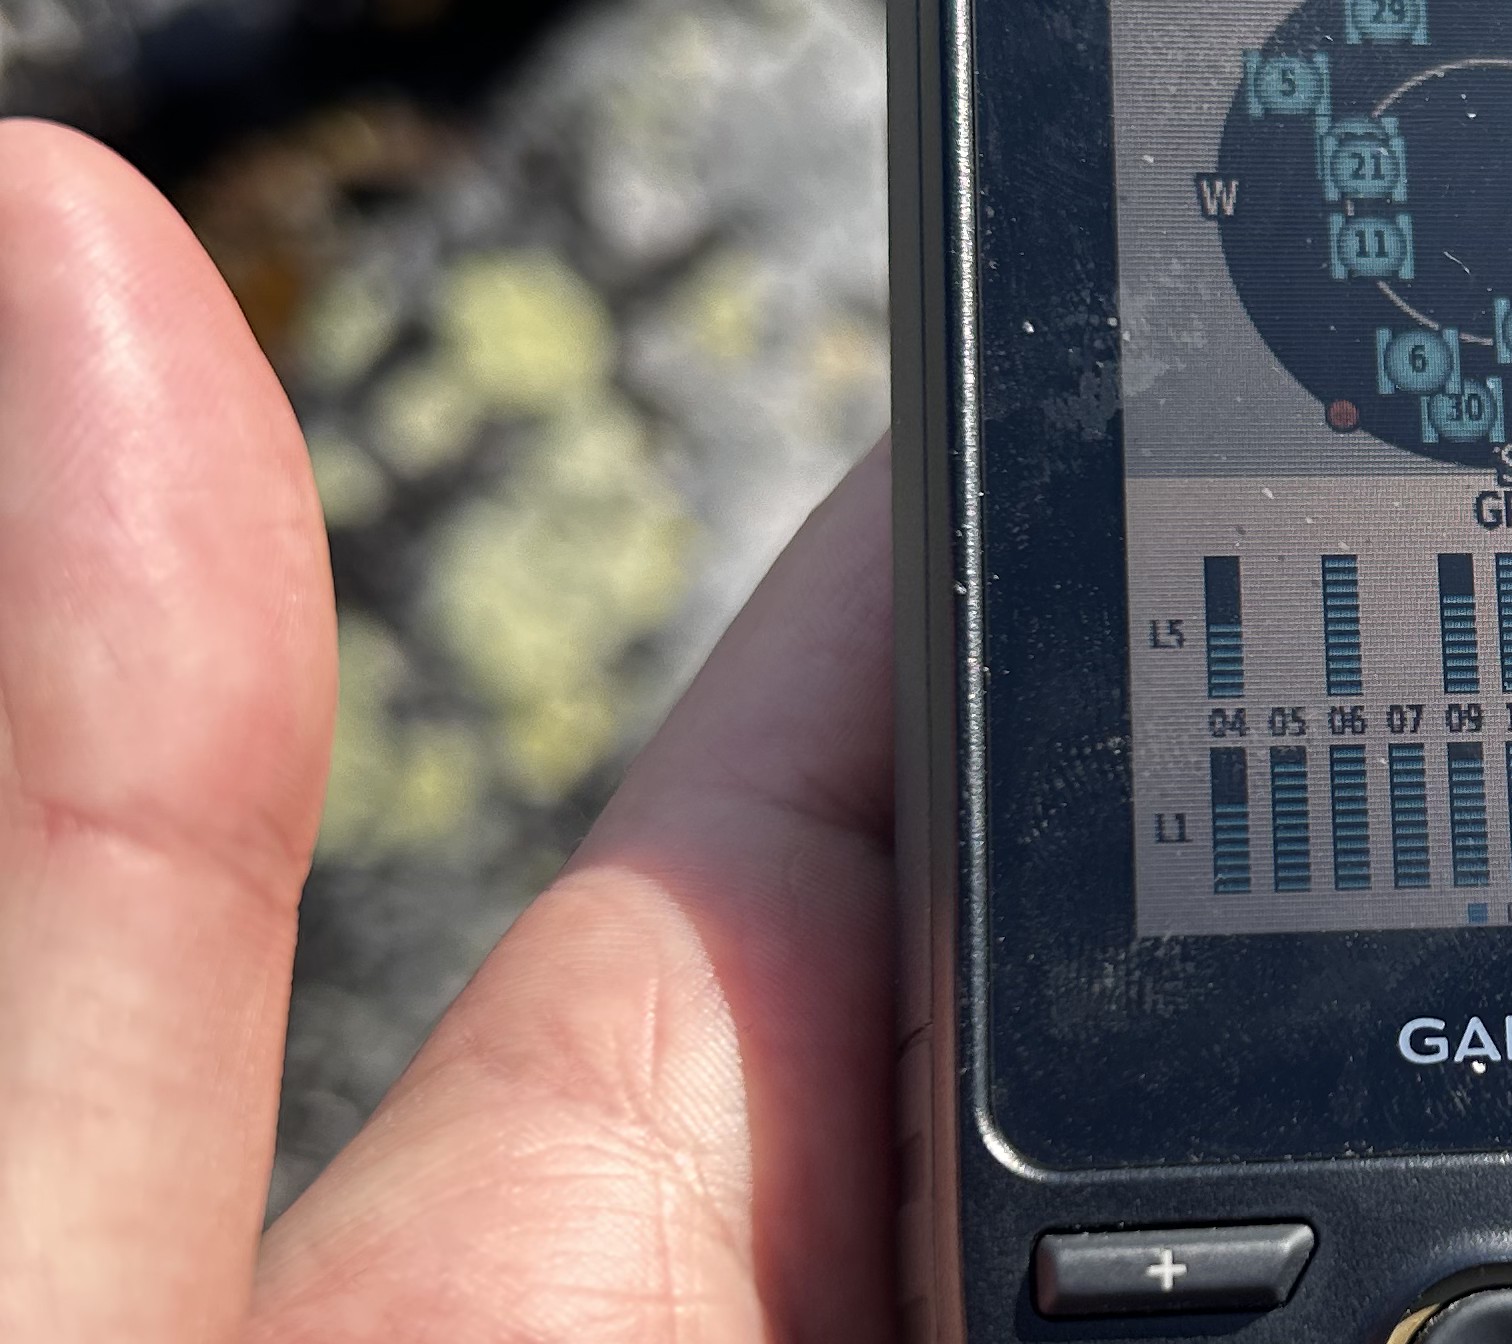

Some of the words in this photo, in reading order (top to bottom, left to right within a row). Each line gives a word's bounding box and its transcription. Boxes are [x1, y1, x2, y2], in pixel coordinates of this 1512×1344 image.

[1280, 68, 1296, 96] 5
[1349, 153, 1385, 181] 21
[1200, 179, 1239, 216] W
[1355, 230, 1389, 258] 11
[1409, 345, 1426, 373] 6
[1149, 620, 1186, 649] L5
[1208, 708, 1248, 737] 04
[1270, 707, 1306, 736] 05
[1328, 706, 1367, 735] 06
[1387, 705, 1425, 733] 07
[1446, 704, 1482, 732] 09
